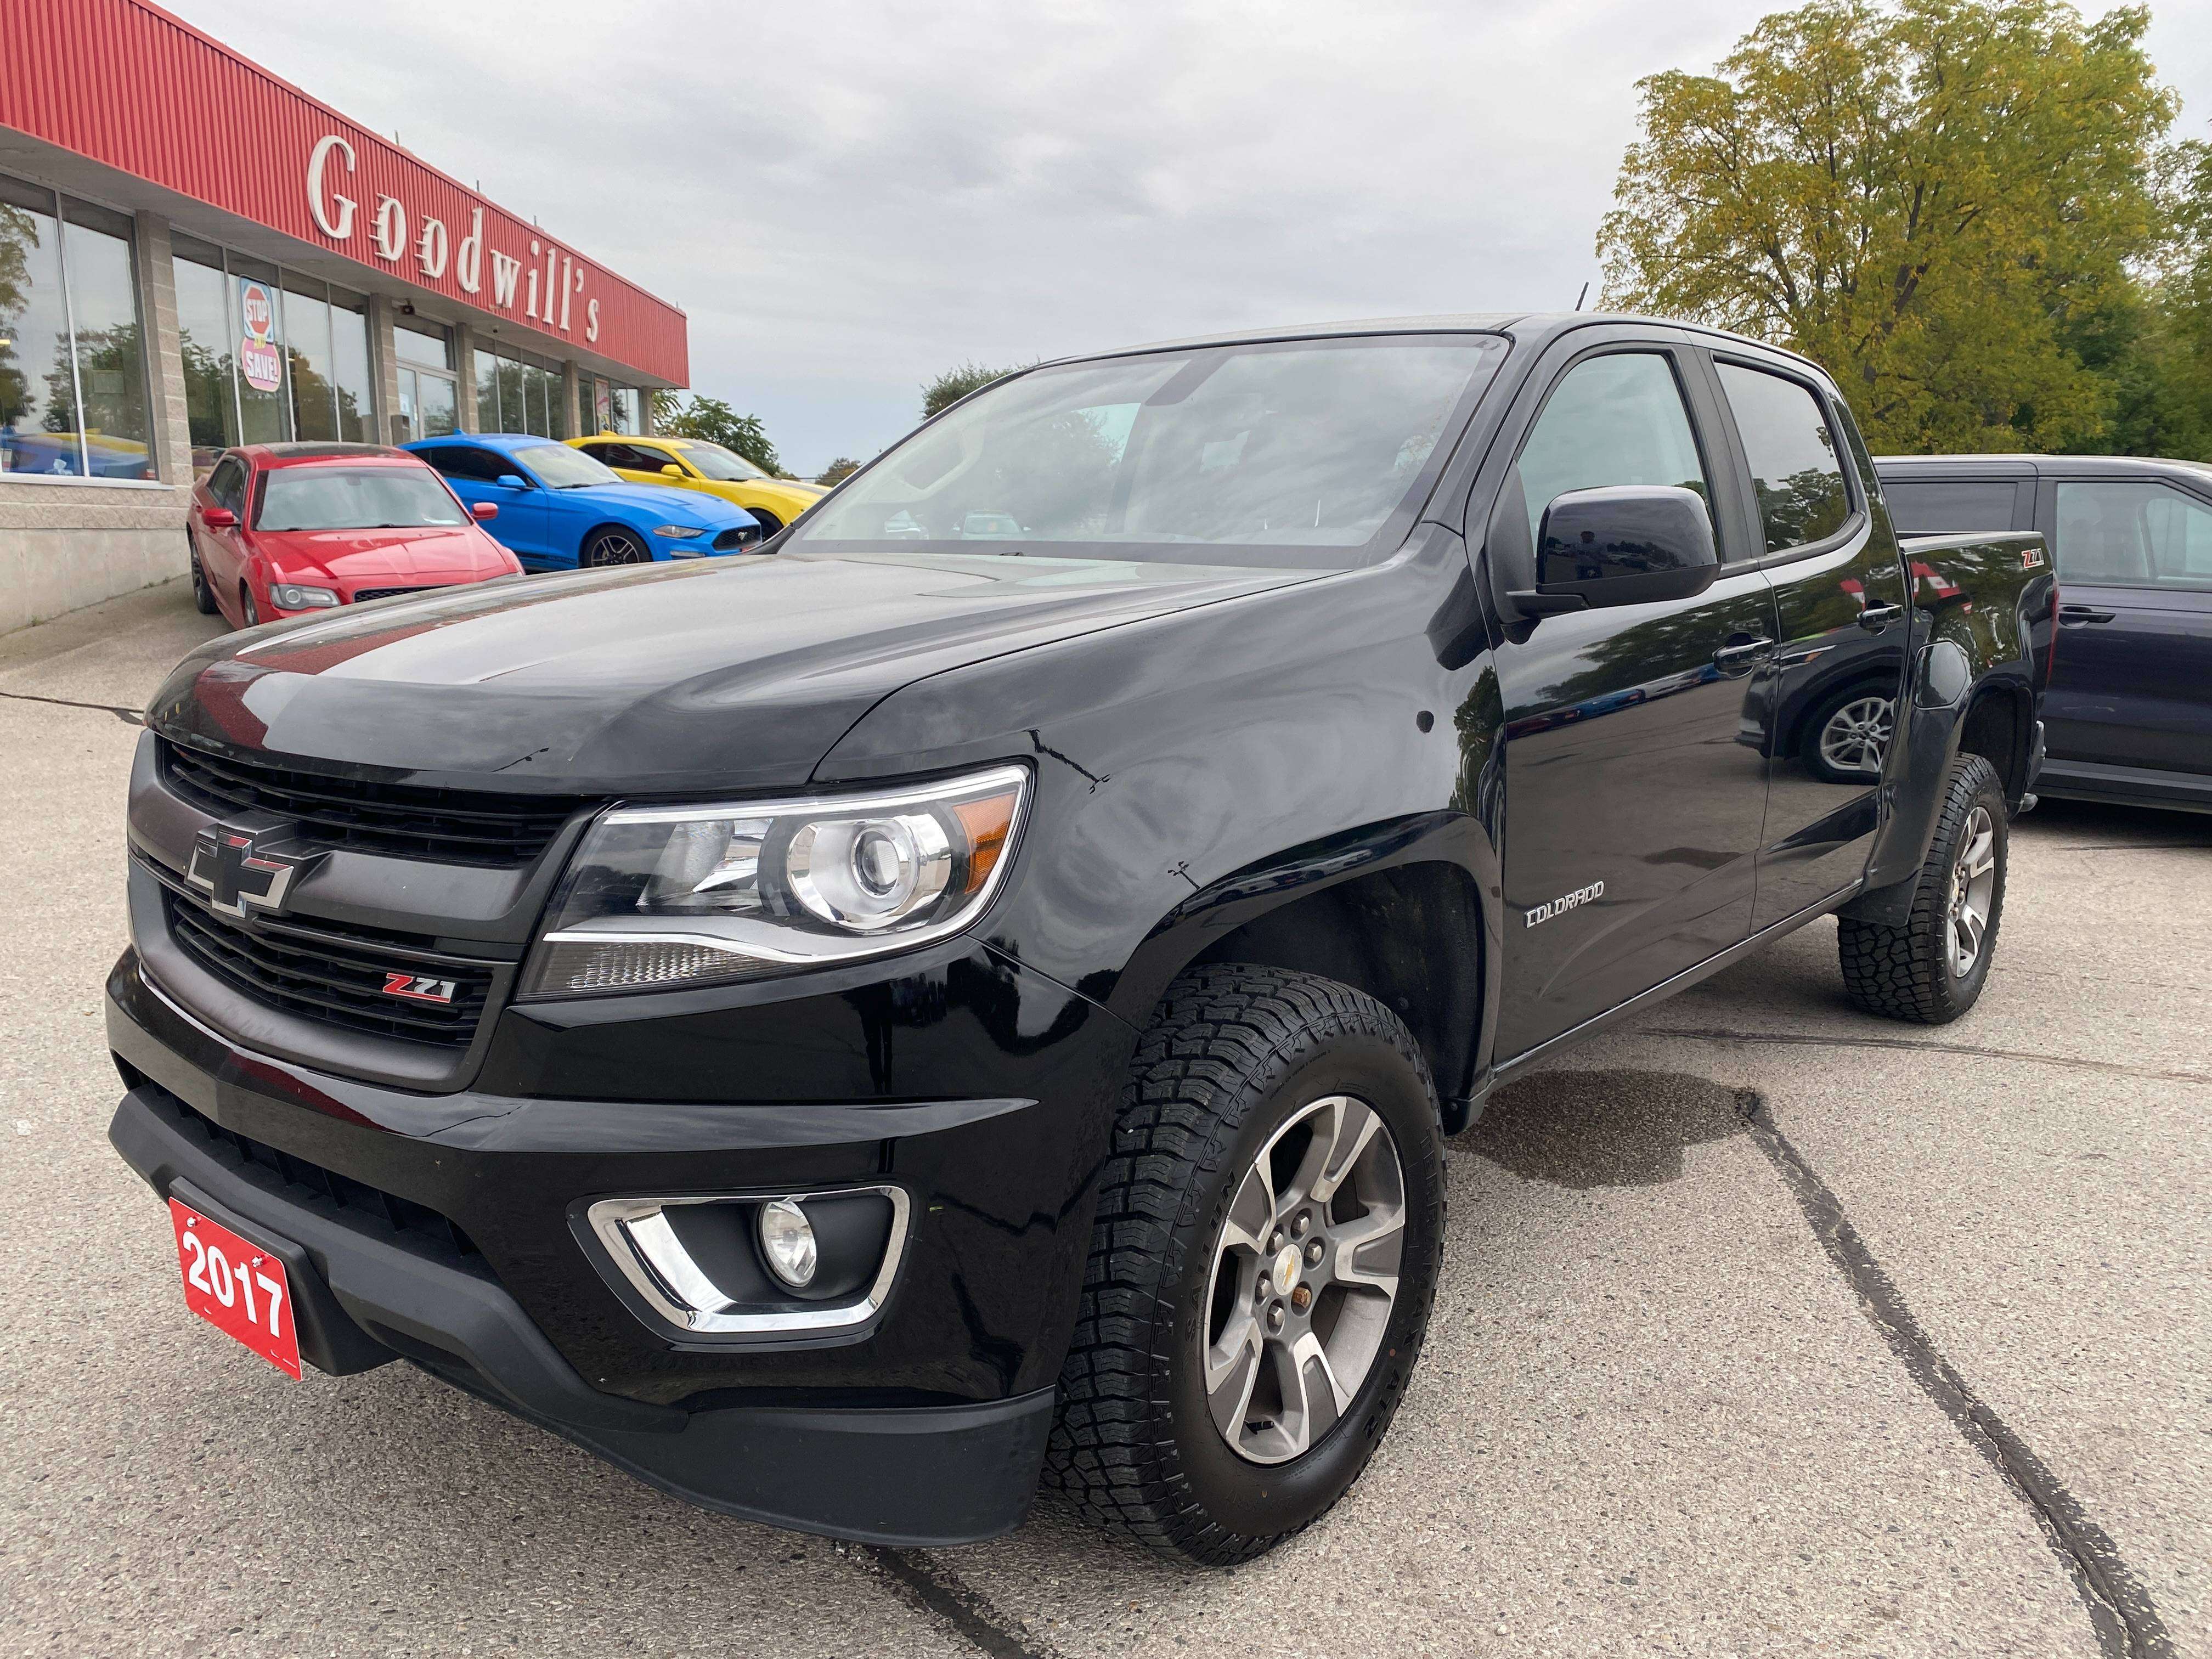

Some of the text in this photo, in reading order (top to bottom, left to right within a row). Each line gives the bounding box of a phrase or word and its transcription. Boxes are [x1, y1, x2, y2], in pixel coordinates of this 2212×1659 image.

[307, 134, 599, 343] Goodwill's
[246, 299, 268, 323] STOP
[245, 351, 279, 383] SAVE!
[2021, 548, 2045, 568] Z71
[1524, 881, 1605, 929] COLORADO
[382, 973, 456, 1003] Z71
[183, 1231, 283, 1339] 2017
